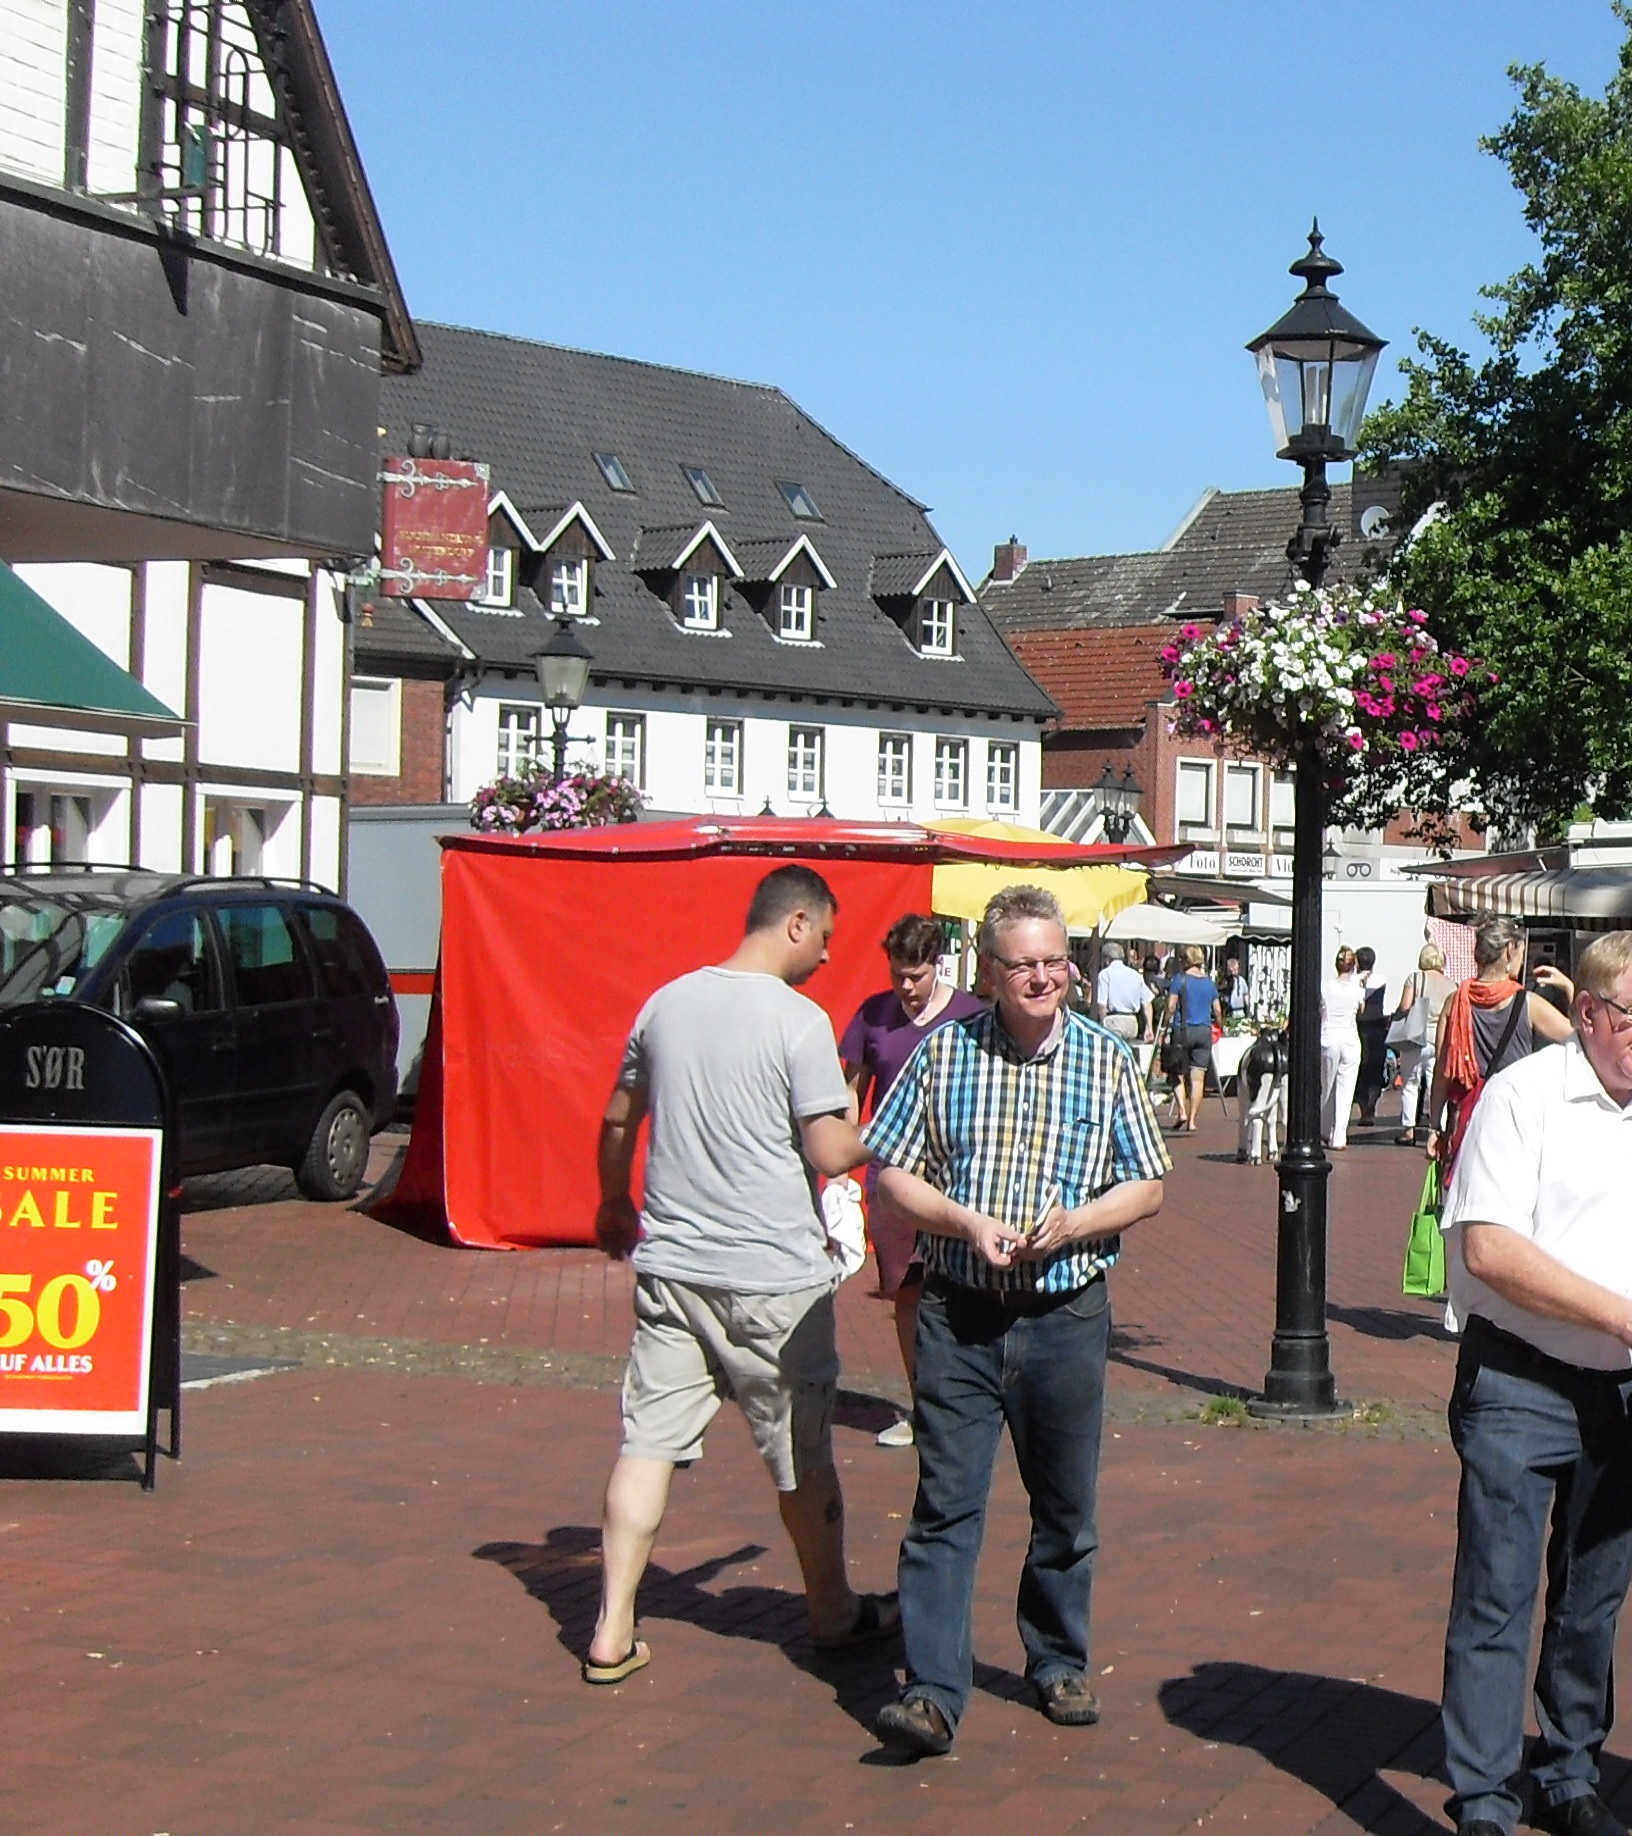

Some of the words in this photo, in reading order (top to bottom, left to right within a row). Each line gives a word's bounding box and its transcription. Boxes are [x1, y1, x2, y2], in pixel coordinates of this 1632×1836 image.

[1189, 852, 1216, 870] Foto
[3, 1165, 95, 1183] SUMMER
[0, 1188, 119, 1230] ALE
[0, 1353, 28, 1372] UF
[30, 1354, 94, 1373] ALLES
